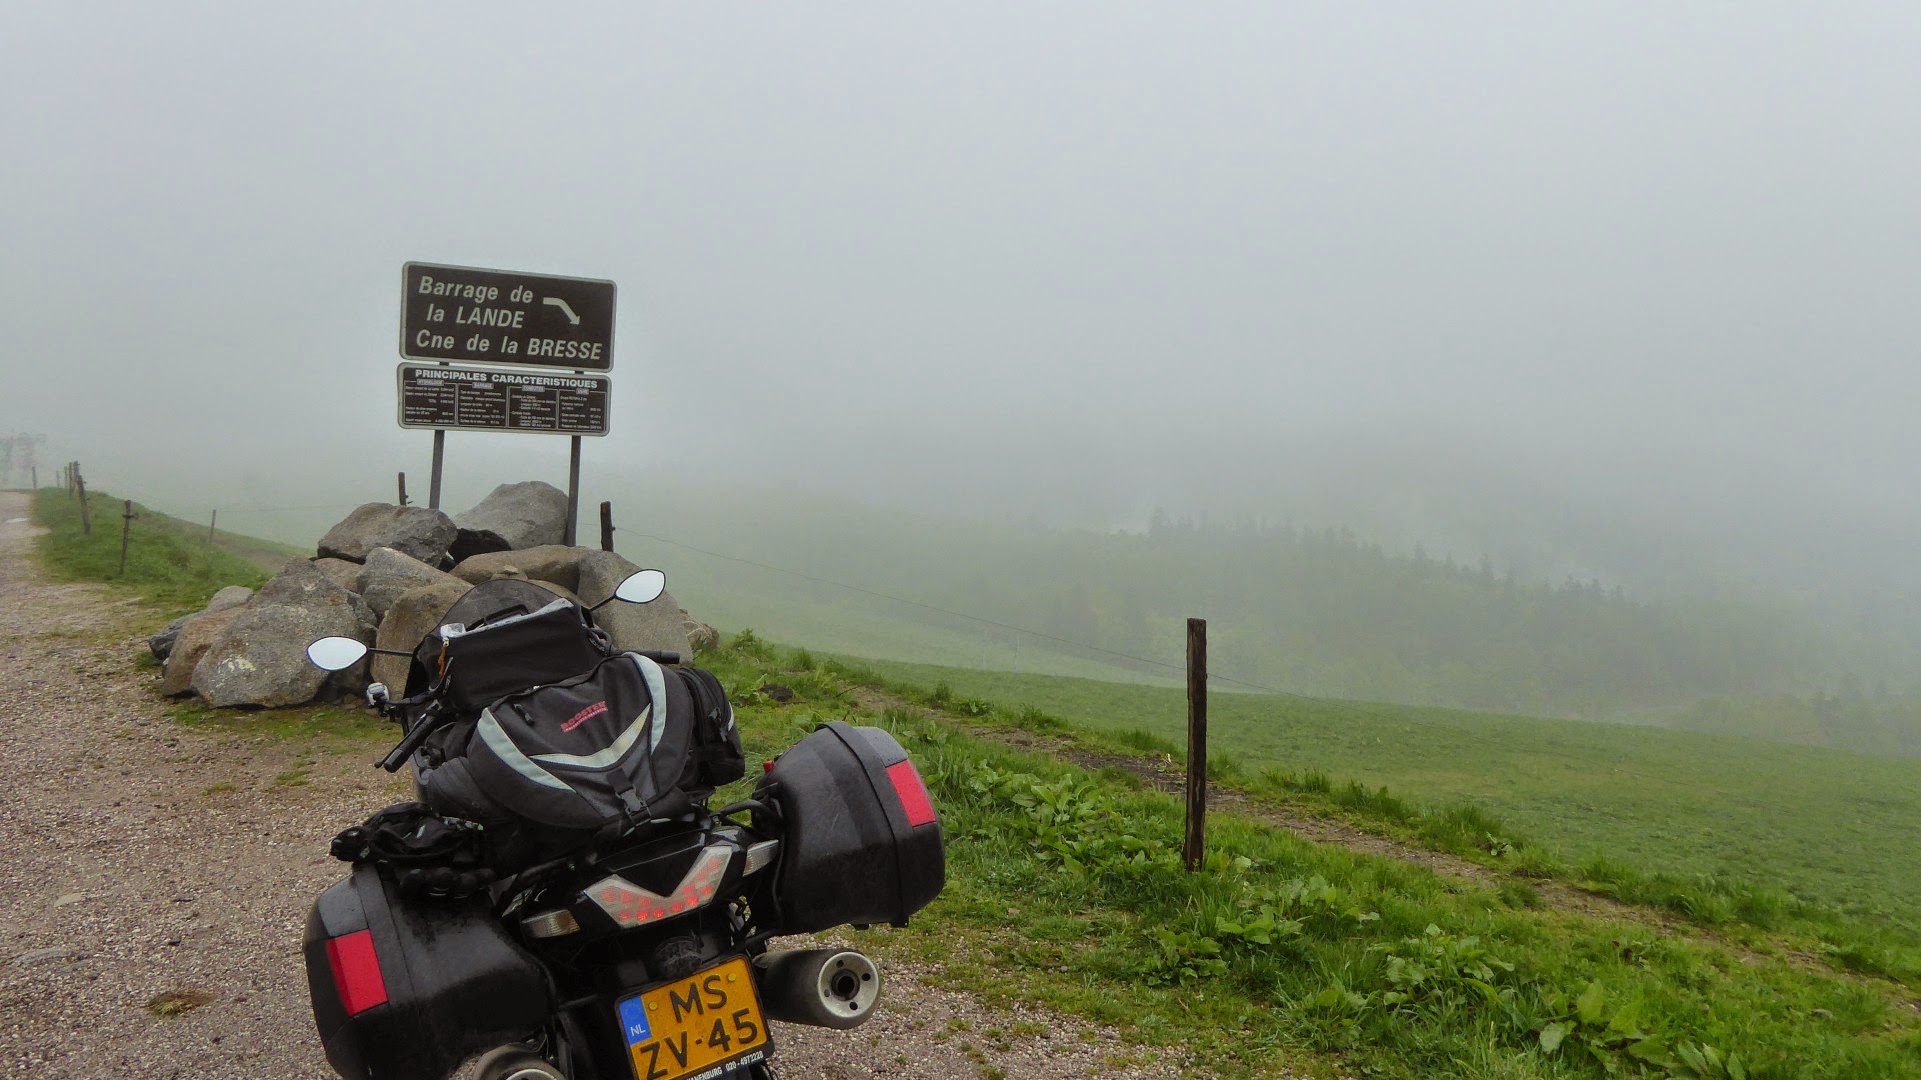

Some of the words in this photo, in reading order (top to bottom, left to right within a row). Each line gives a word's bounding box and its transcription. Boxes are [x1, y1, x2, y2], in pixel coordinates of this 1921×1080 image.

[419, 275, 499, 304] Barrage
[510, 285, 534, 304] de
[426, 303, 445, 322] la
[455, 305, 525, 329] LANDE
[416, 329, 455, 349] Cne
[466, 333, 490, 352] de
[501, 335, 519, 354] la
[527, 338, 603, 360] BRESSE
[415, 369, 487, 381] PRINCIPALES
[491, 374, 598, 389] CARACTERISTIQUES
[669, 974, 728, 1024] MS
[630, 1023, 646, 1037] NL
